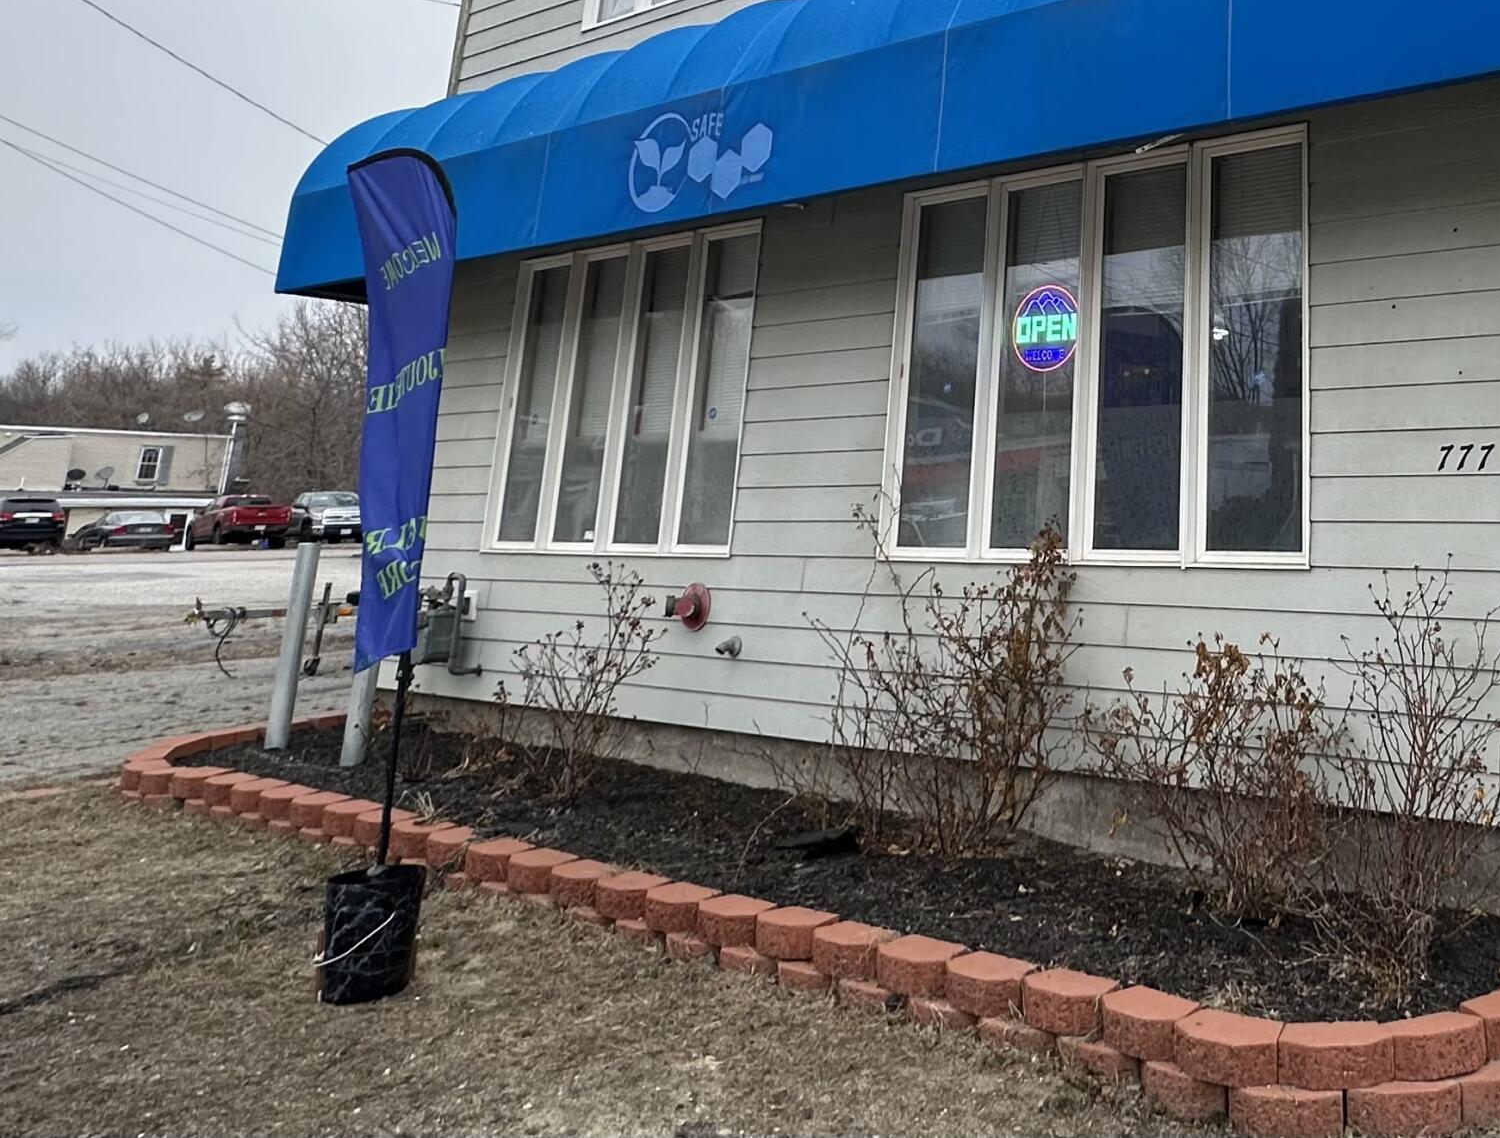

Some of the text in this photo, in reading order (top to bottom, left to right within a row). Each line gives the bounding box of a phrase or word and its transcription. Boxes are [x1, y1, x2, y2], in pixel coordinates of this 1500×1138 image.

[691, 113, 724, 141] SAFE
[1016, 312, 1077, 343] OPEN
[1437, 443, 1495, 471] 777
